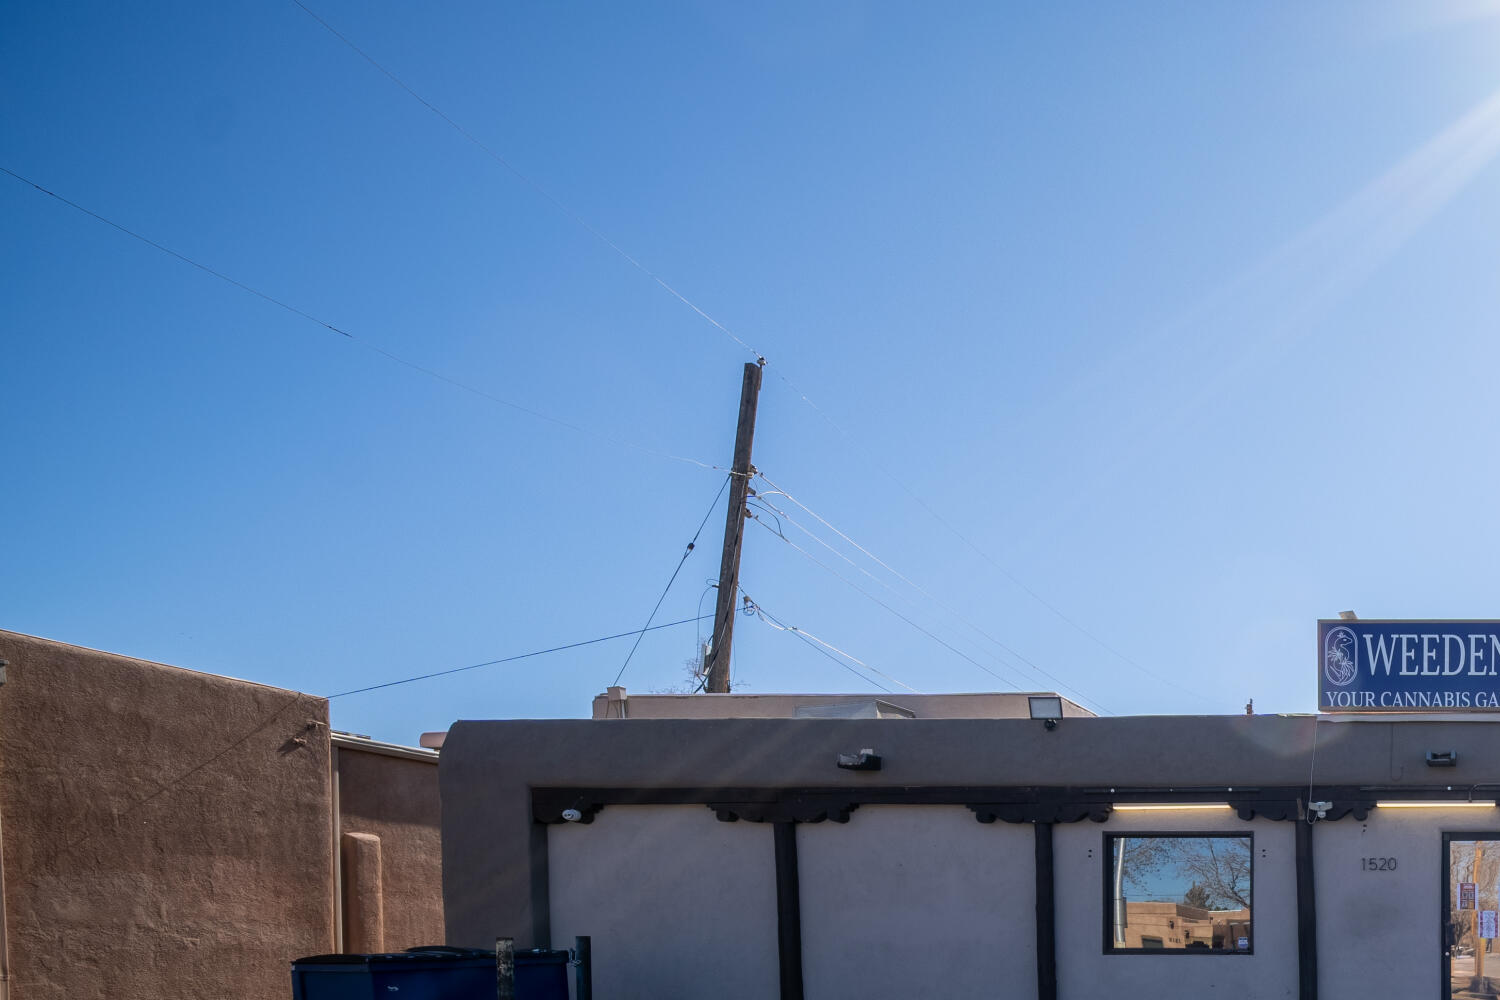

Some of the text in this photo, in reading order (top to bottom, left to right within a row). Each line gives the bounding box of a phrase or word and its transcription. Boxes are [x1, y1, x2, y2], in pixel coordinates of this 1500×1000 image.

[1326, 691, 1376, 707] YOUR
[1380, 691, 1471, 707] CANNABIS
[1361, 857, 1397, 871] 1520
